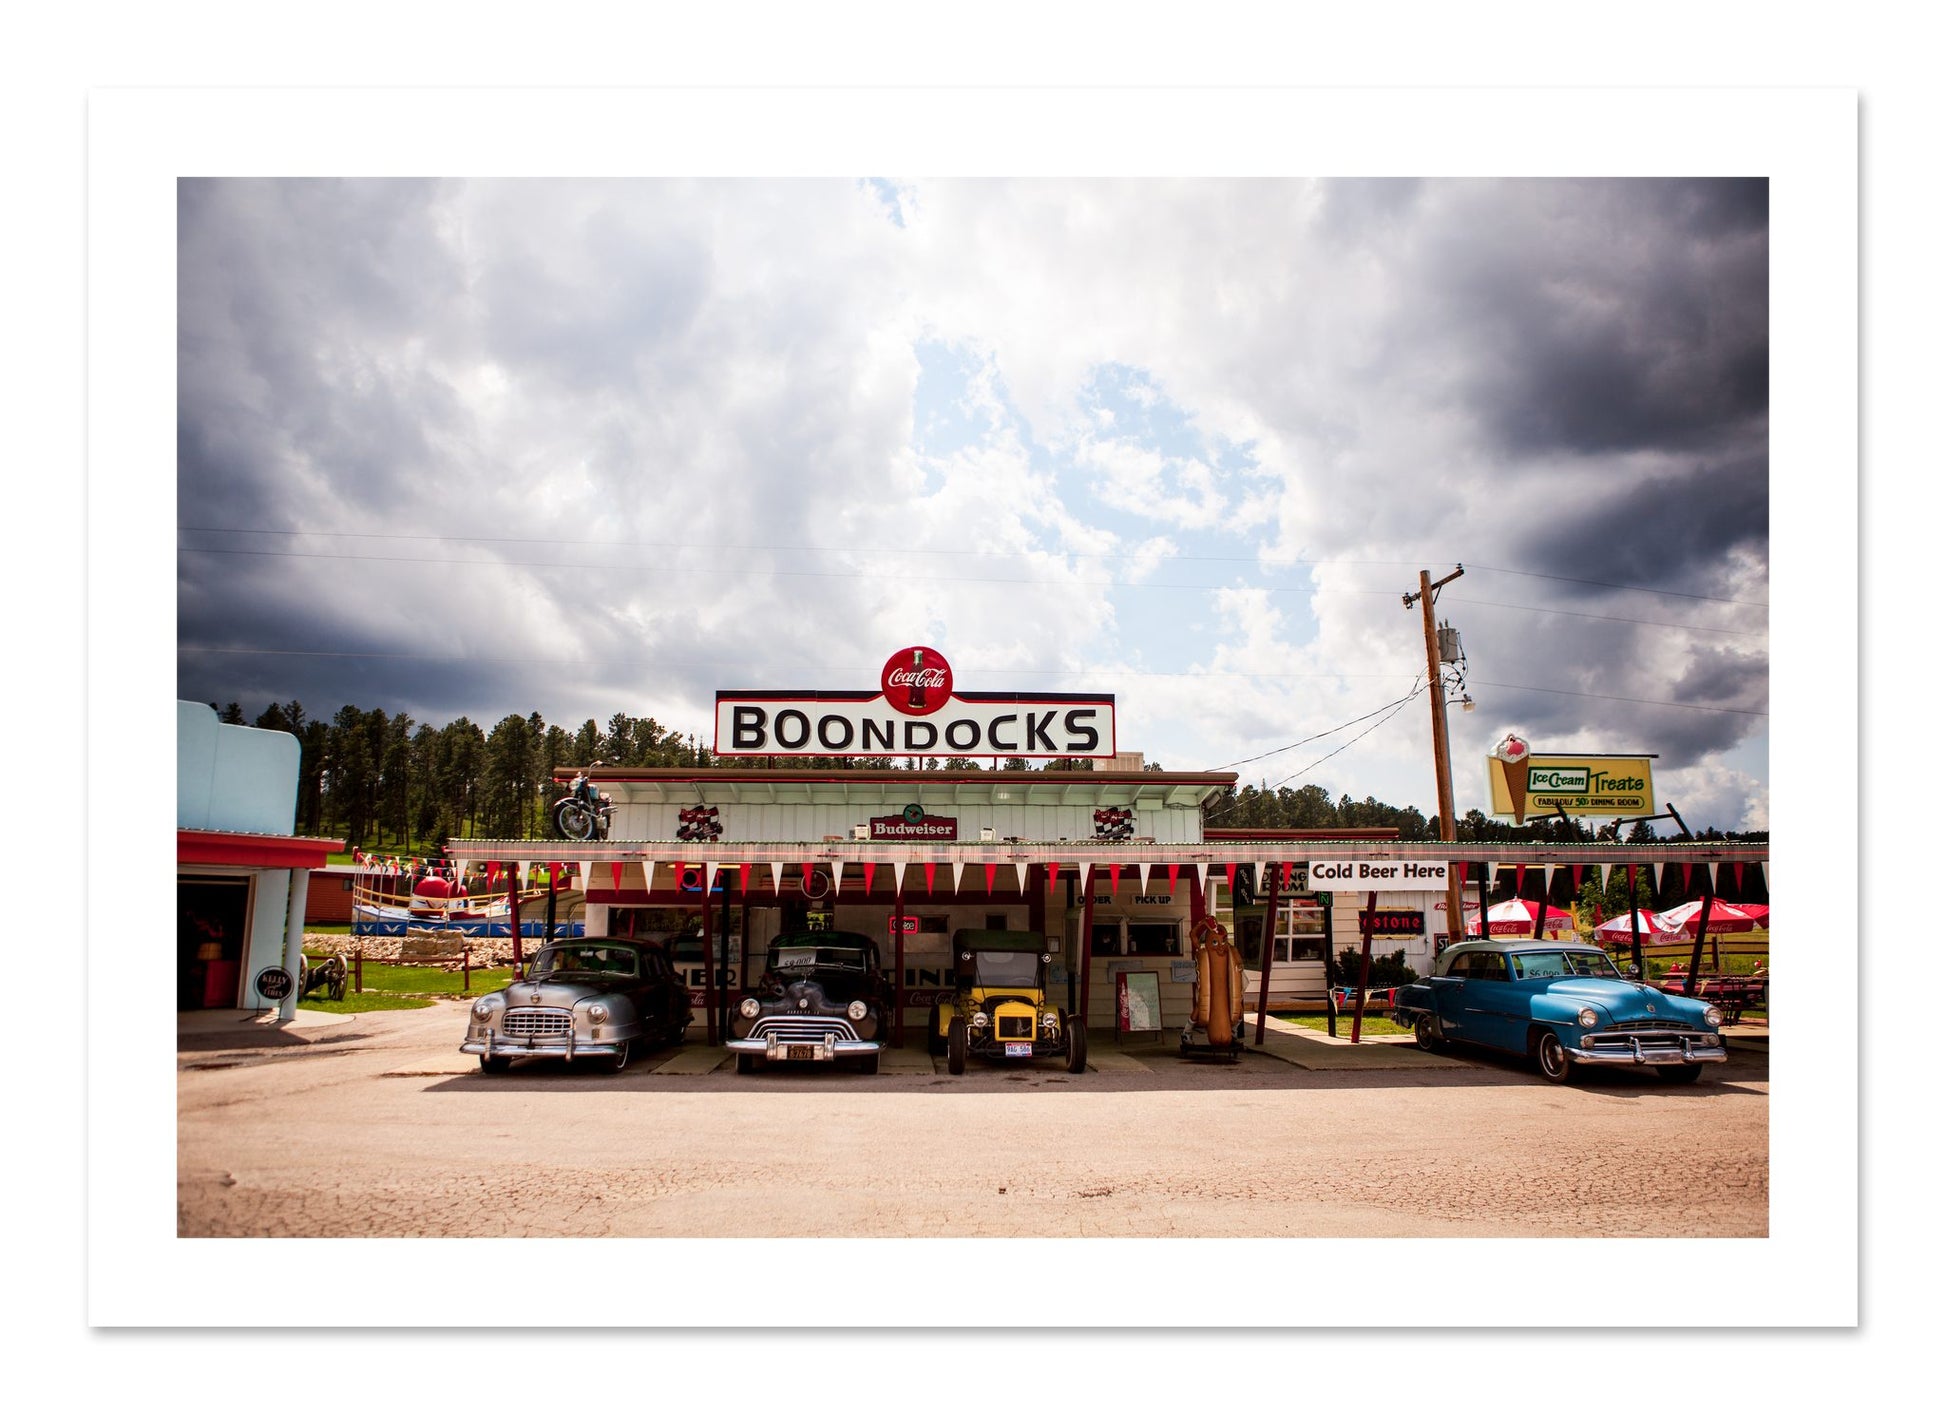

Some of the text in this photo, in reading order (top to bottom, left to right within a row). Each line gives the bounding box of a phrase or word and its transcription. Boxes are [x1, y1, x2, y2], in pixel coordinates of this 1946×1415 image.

[732, 706, 1099, 752] BOONDOCKS
[1533, 771, 1645, 793] Ice Cream Treats
[874, 823, 953, 835] Budweiser
[1312, 863, 1446, 878] Cold Beer Here
[1135, 895, 1171, 904] PICK UP
